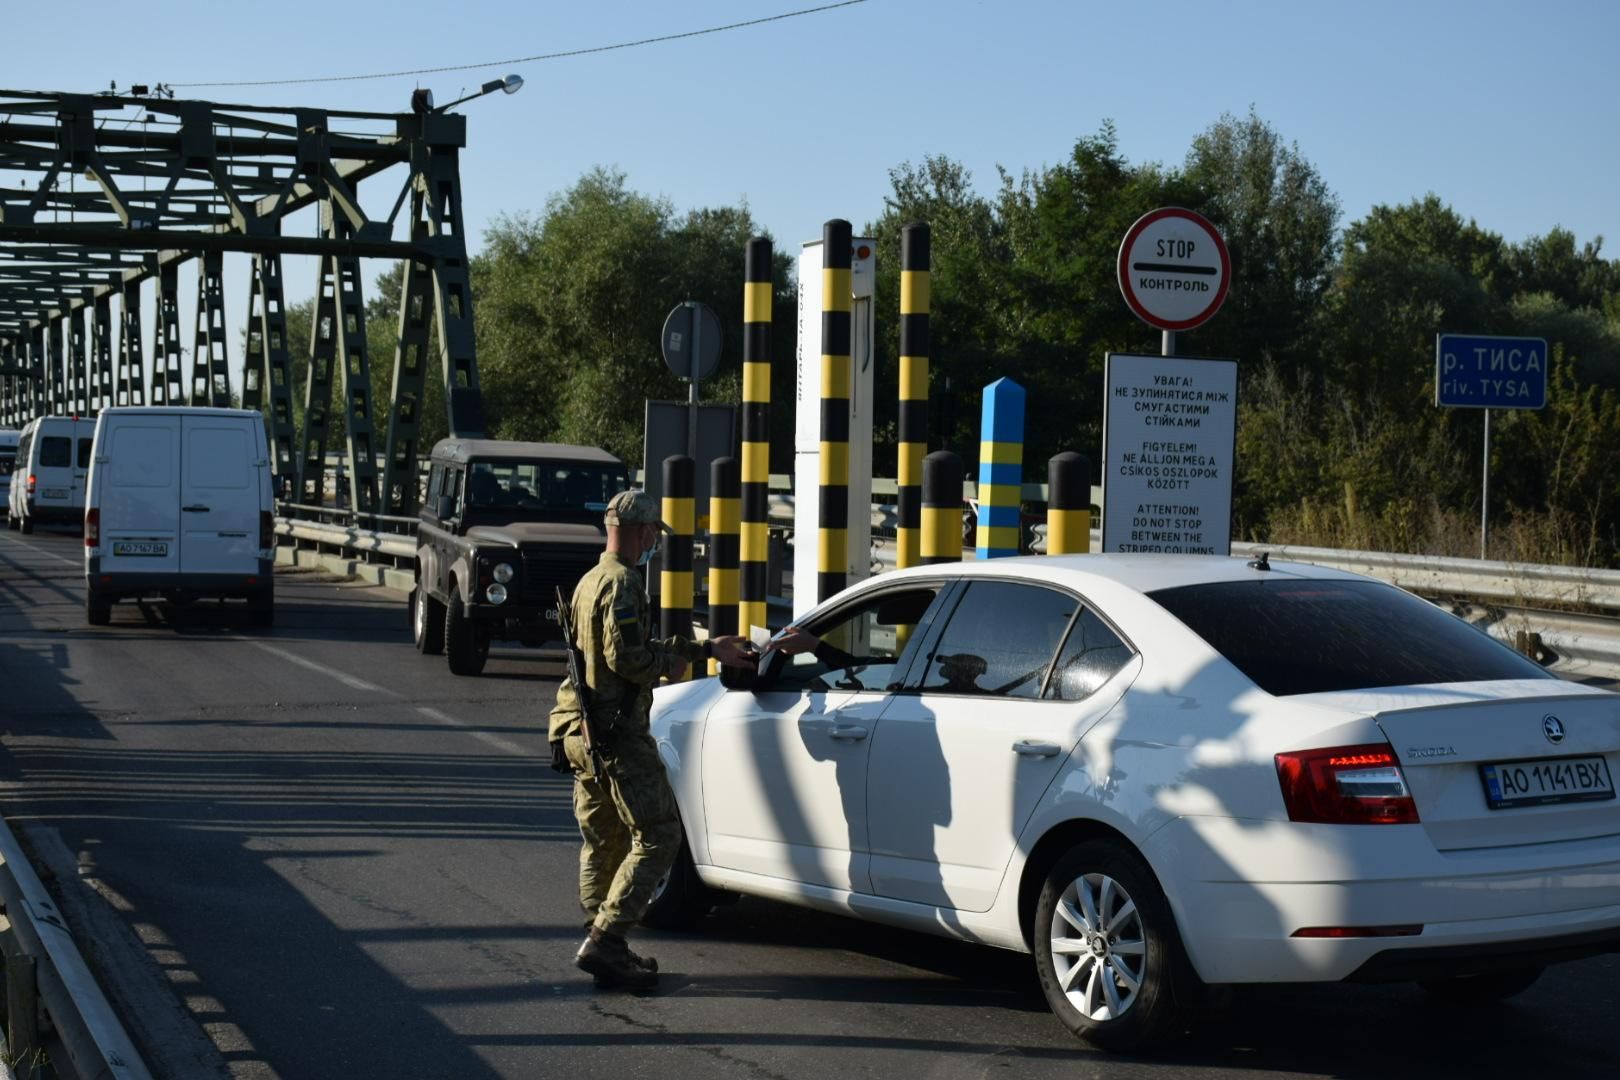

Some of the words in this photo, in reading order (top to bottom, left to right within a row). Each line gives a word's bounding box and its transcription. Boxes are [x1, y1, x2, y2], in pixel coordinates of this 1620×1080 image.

[1156, 238, 1196, 259] STOP
[1139, 277, 1209, 292] КОНТРОЛЬ
[1473, 347, 1540, 372] ТИСА
[1153, 375, 1193, 387] УВАГА!
[1443, 379, 1473, 395] riv.
[1480, 379, 1529, 397] TYSA
[1115, 387, 1128, 398] НЕ
[1131, 388, 1202, 400] ЗУПИНЯТИСЯ
[1205, 392, 1229, 402] МІЖ
[1134, 401, 1210, 415] СМУГАСТИМИ
[1144, 414, 1200, 428] СТІЙКАМИ
[1142, 441, 1197, 453] FIGYELEM!
[1123, 453, 1136, 464] NE
[1183, 455, 1205, 466] MEG
[1208, 456, 1216, 466] A
[1162, 467, 1218, 479] OSZLOPOK
[1137, 504, 1199, 516] ATTENTION!
[1132, 517, 1147, 528] DO
[1149, 517, 1171, 528] NOT
[1174, 518, 1202, 529] STOP
[1131, 531, 1180, 542] BETWEEN
[1183, 532, 1202, 543] THE
[1502, 767, 1529, 795] AO
